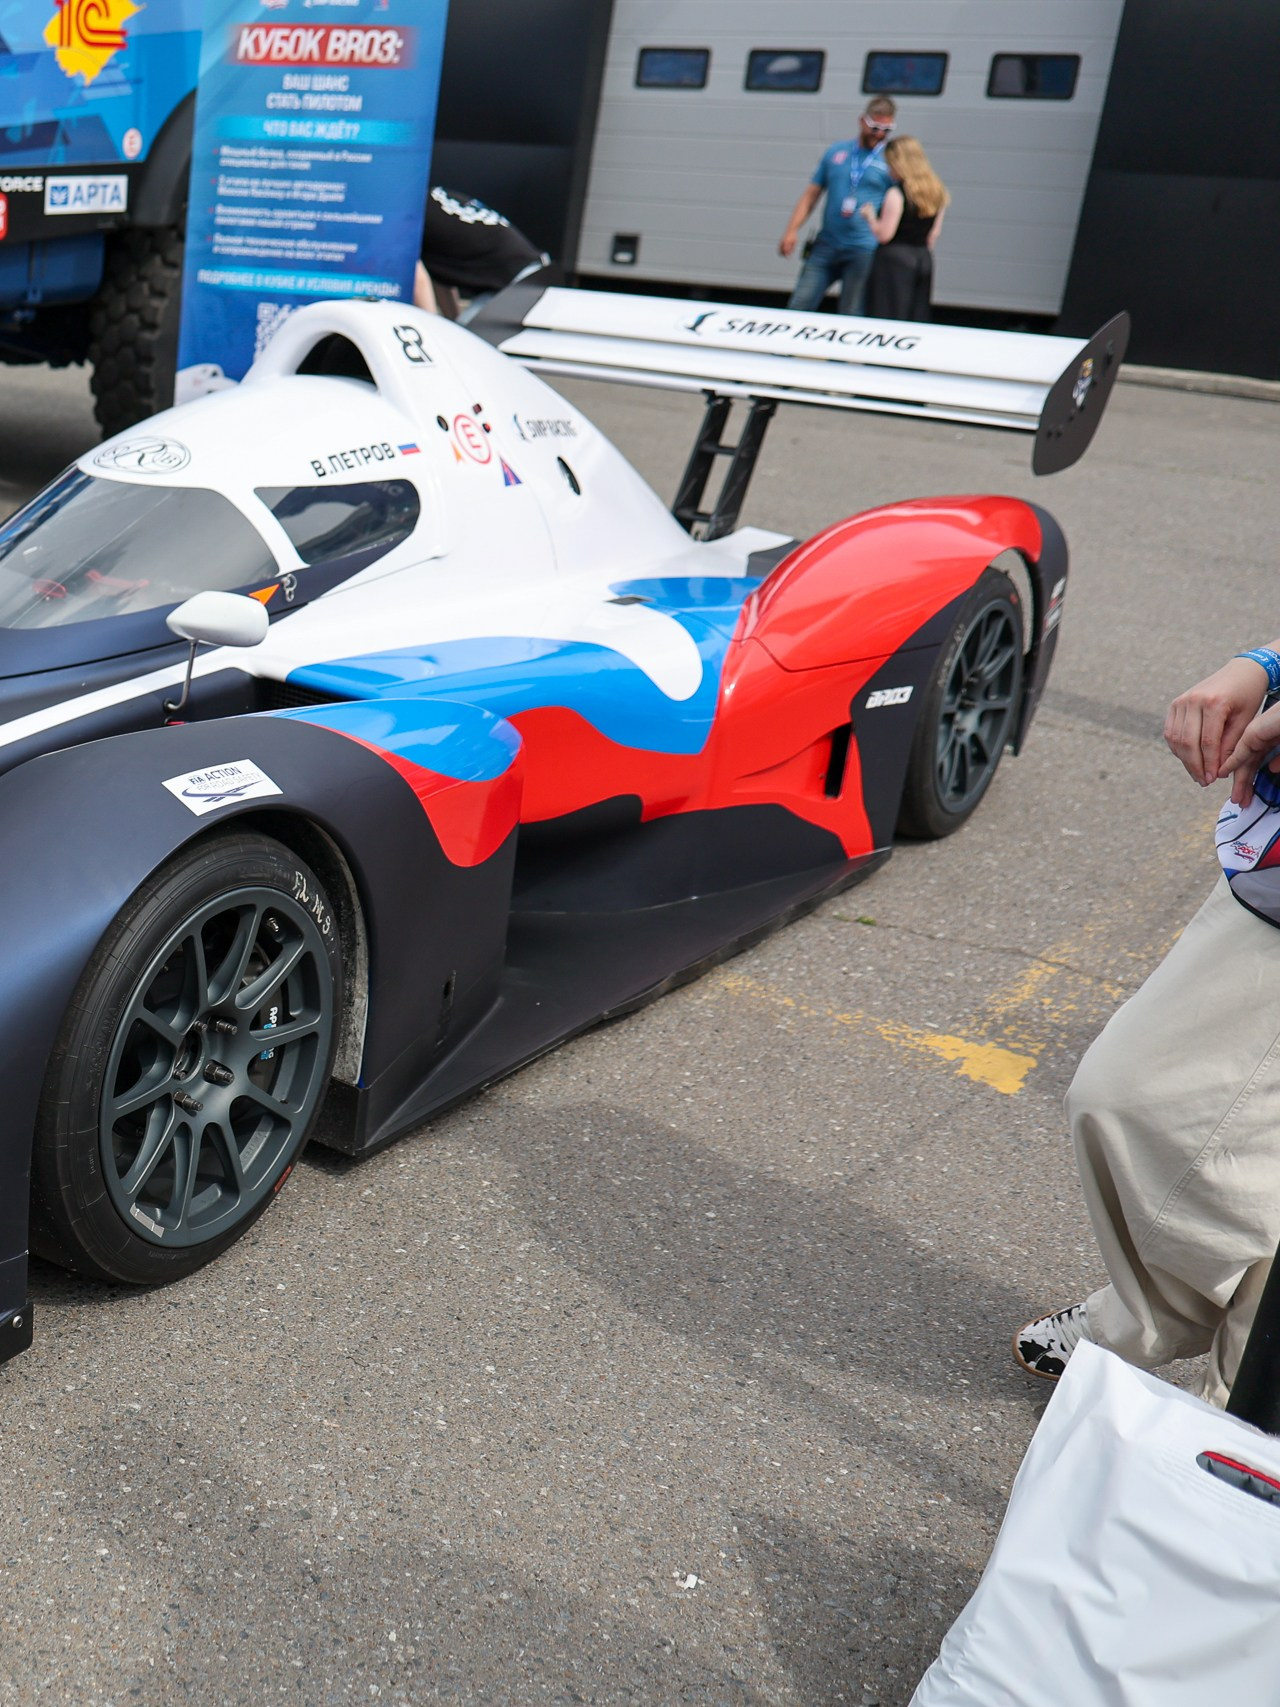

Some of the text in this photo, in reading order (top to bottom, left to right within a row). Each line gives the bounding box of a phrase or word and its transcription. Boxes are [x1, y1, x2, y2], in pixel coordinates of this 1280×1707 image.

[236, 27, 326, 62] КУБОК
[719, 315, 923, 352] SMP RACING
[310, 442, 396, 478] В.ПЕТРОВ
[189, 766, 242, 785] FIA ACTION
[197, 784, 211, 792] FOR
[211, 778, 235, 790] ROAD
